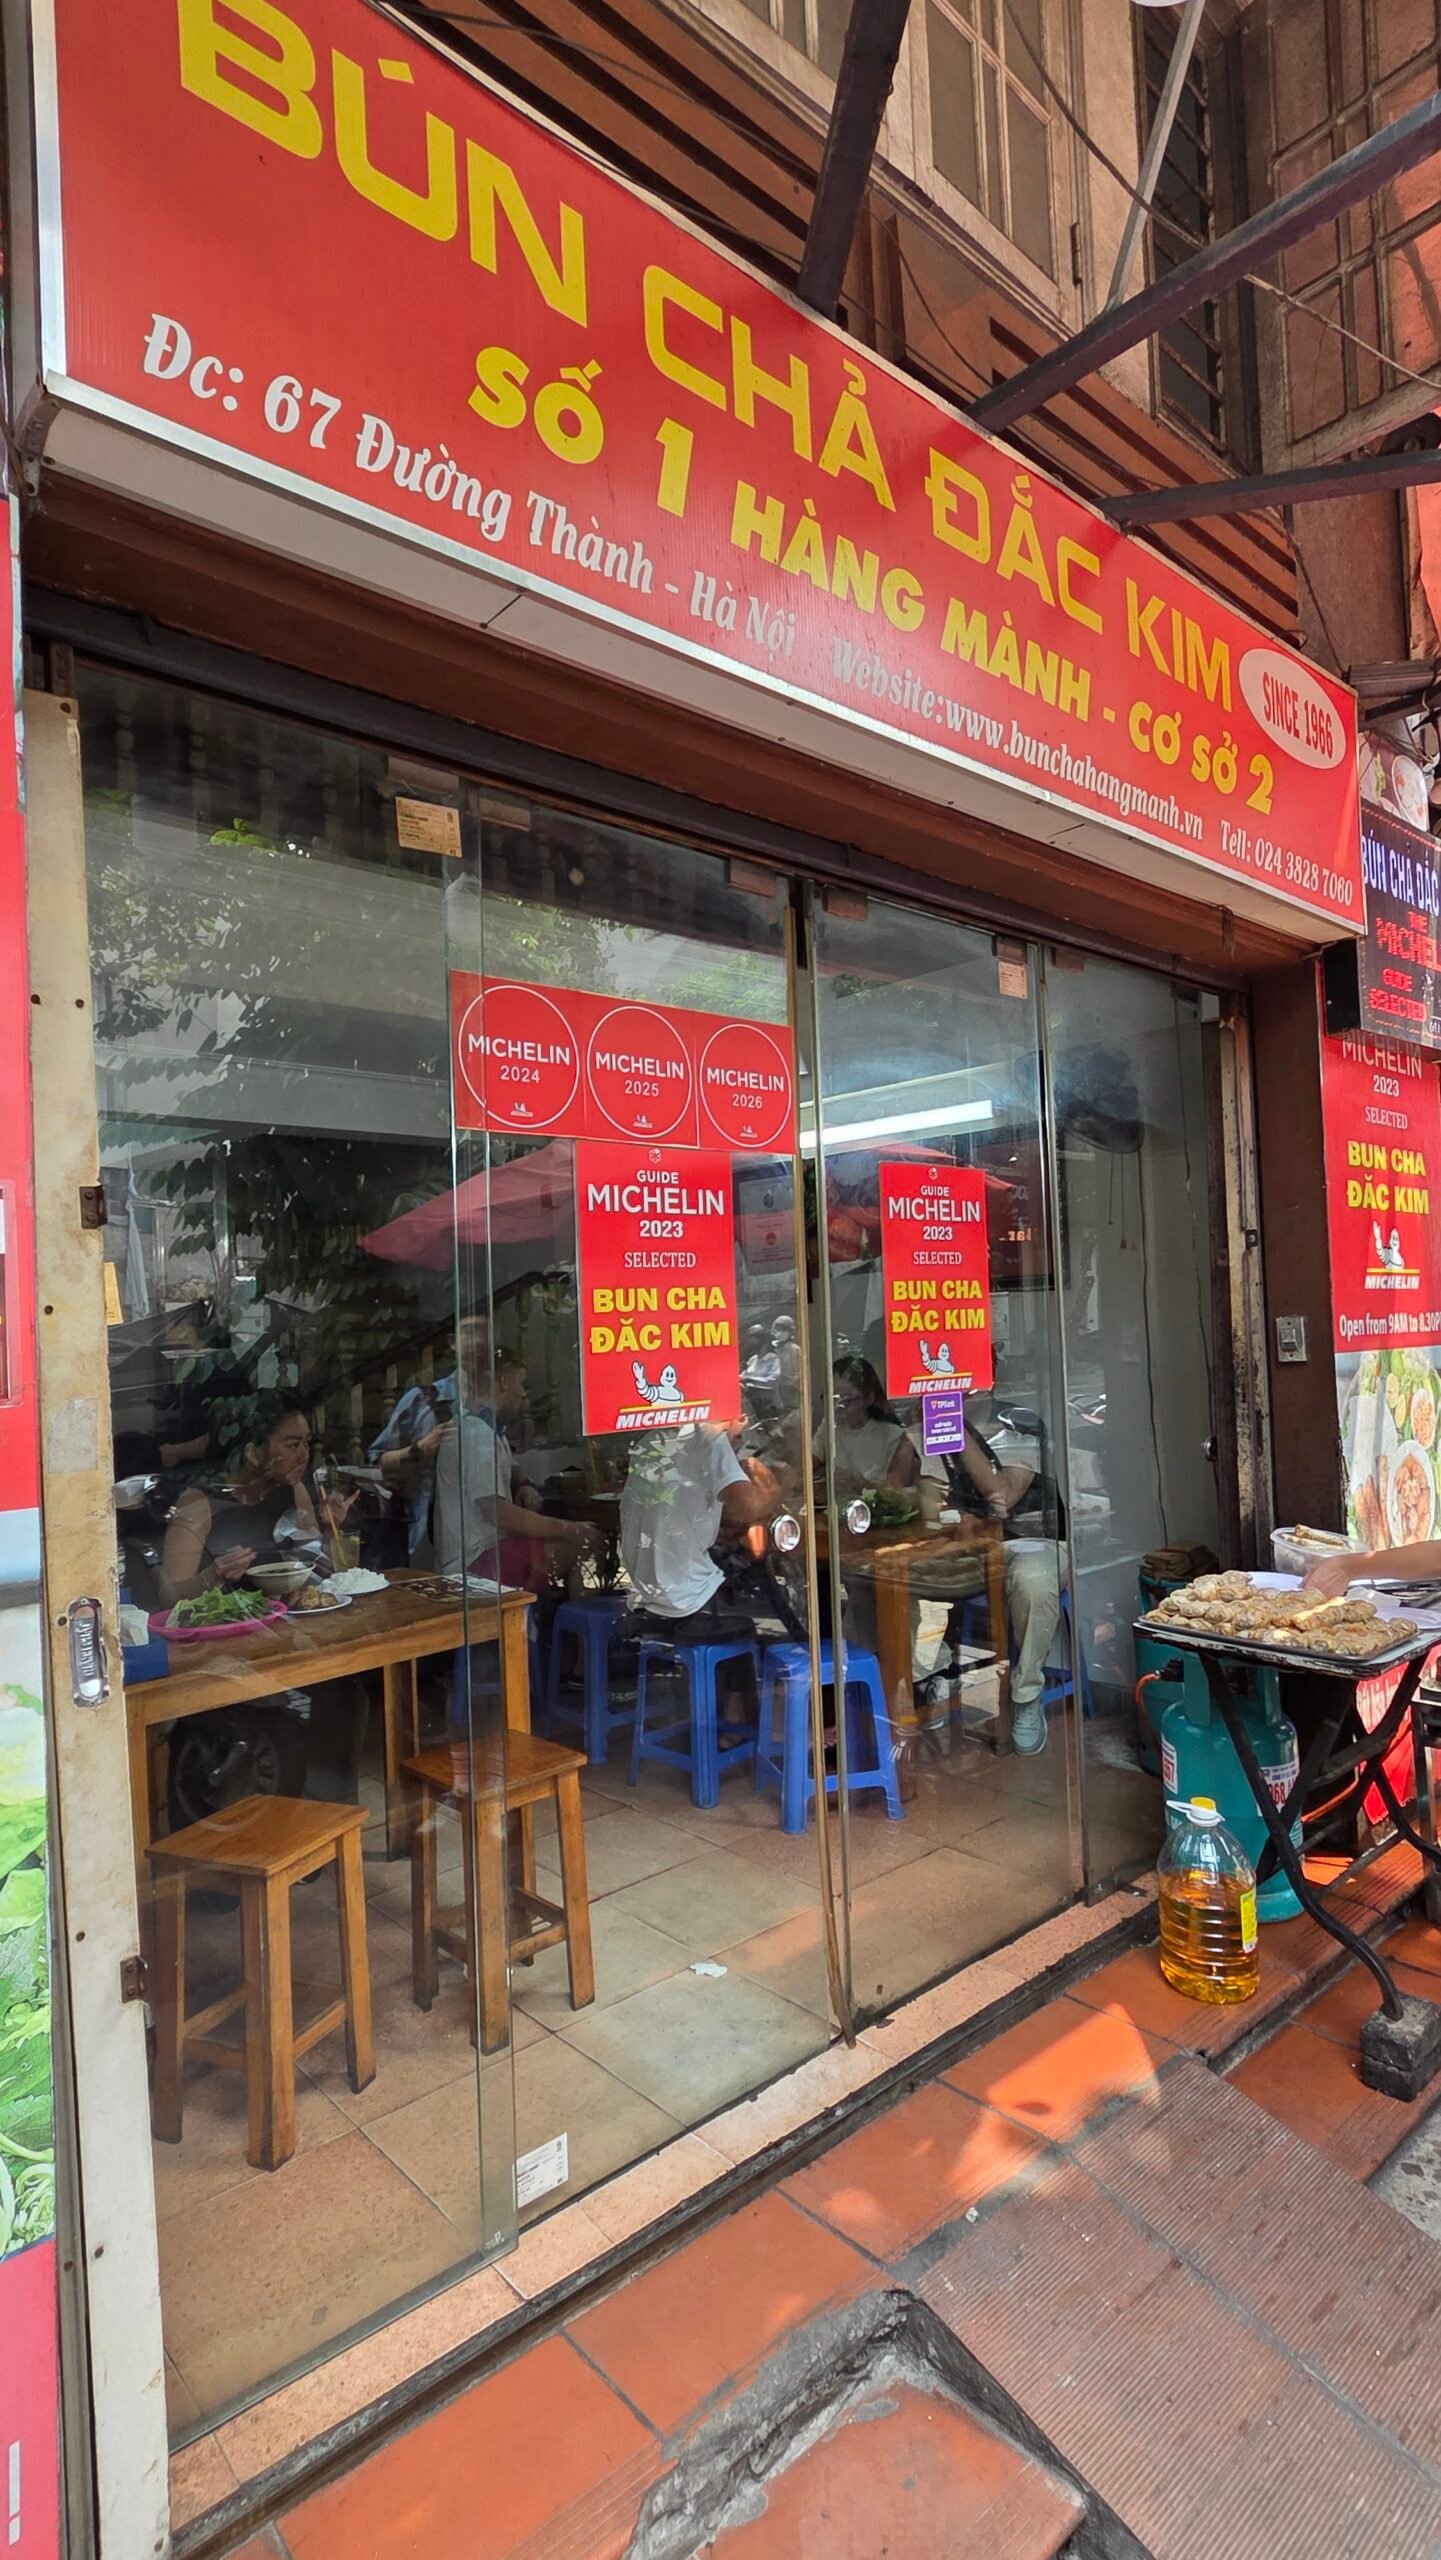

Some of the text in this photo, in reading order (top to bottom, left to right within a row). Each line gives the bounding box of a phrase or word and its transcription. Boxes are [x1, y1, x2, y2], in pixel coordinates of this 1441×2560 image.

[643, 264, 897, 512] CHẢ
[924, 446, 1103, 635] ĐẮC
[1126, 577, 1232, 712] KIM
[143, 312, 244, 412] Đc:
[264, 374, 343, 449] 67
[355, 413, 512, 542] Đường
[526, 490, 653, 593] Thành
[690, 570, 737, 631] Hà
[745, 595, 796, 662] Nội
[1220, 819, 1251, 863] Tell:
[1255, 838, 1283, 876] 024
[1285, 852, 1319, 894] 3828
[1322, 869, 1354, 907] 7060
[655, 416, 694, 518] 1
[730, 479, 926, 632] HÀNG
[940, 597, 1092, 722] MÀNH
[1246, 754, 1274, 816] 2
[1262, 671, 1334, 760] SINCE 1966
[1361, 829, 1387, 893] BÚN
[1376, 917, 1441, 972] MICHEL
[468, 1033, 570, 1066] MICHELIN
[1343, 1040, 1422, 1079] MICHELIN
[500, 1065, 540, 1083] 2024
[595, 1051, 685, 1080] MICHELIN
[624, 1080, 660, 1097] 2025
[706, 1067, 785, 1092] MICHELIN
[1373, 1074, 1400, 1097] 2023
[732, 1093, 763, 1109] 2026
[1365, 1106, 1408, 1130] SELECTED
[1347, 1140, 1427, 1176] BUN CHA
[636, 1170, 679, 1184] GUIDE
[587, 1183, 724, 1216] MICHELIN
[921, 1185, 949, 1197] GUIDE
[1394, 1185, 1430, 1215] KIM
[888, 1196, 981, 1223] MICHELIN
[639, 1220, 683, 1238] 2023
[923, 1226, 953, 1241] 2023
[624, 1252, 696, 1268] SELECTED
[913, 1251, 962, 1265] SELECTED
[893, 1280, 983, 1301] BUN CHA
[1364, 1274, 1421, 1290] MICHELIN
[593, 1286, 727, 1313] BUN CHA
[945, 1308, 985, 1330] KIM
[1339, 1310, 1441, 1343] Open from 9AM to 8.30P
[670, 1321, 730, 1349] KIM
[908, 1377, 972, 1394] MICHELIN
[615, 1406, 710, 1430] MICHELIN
